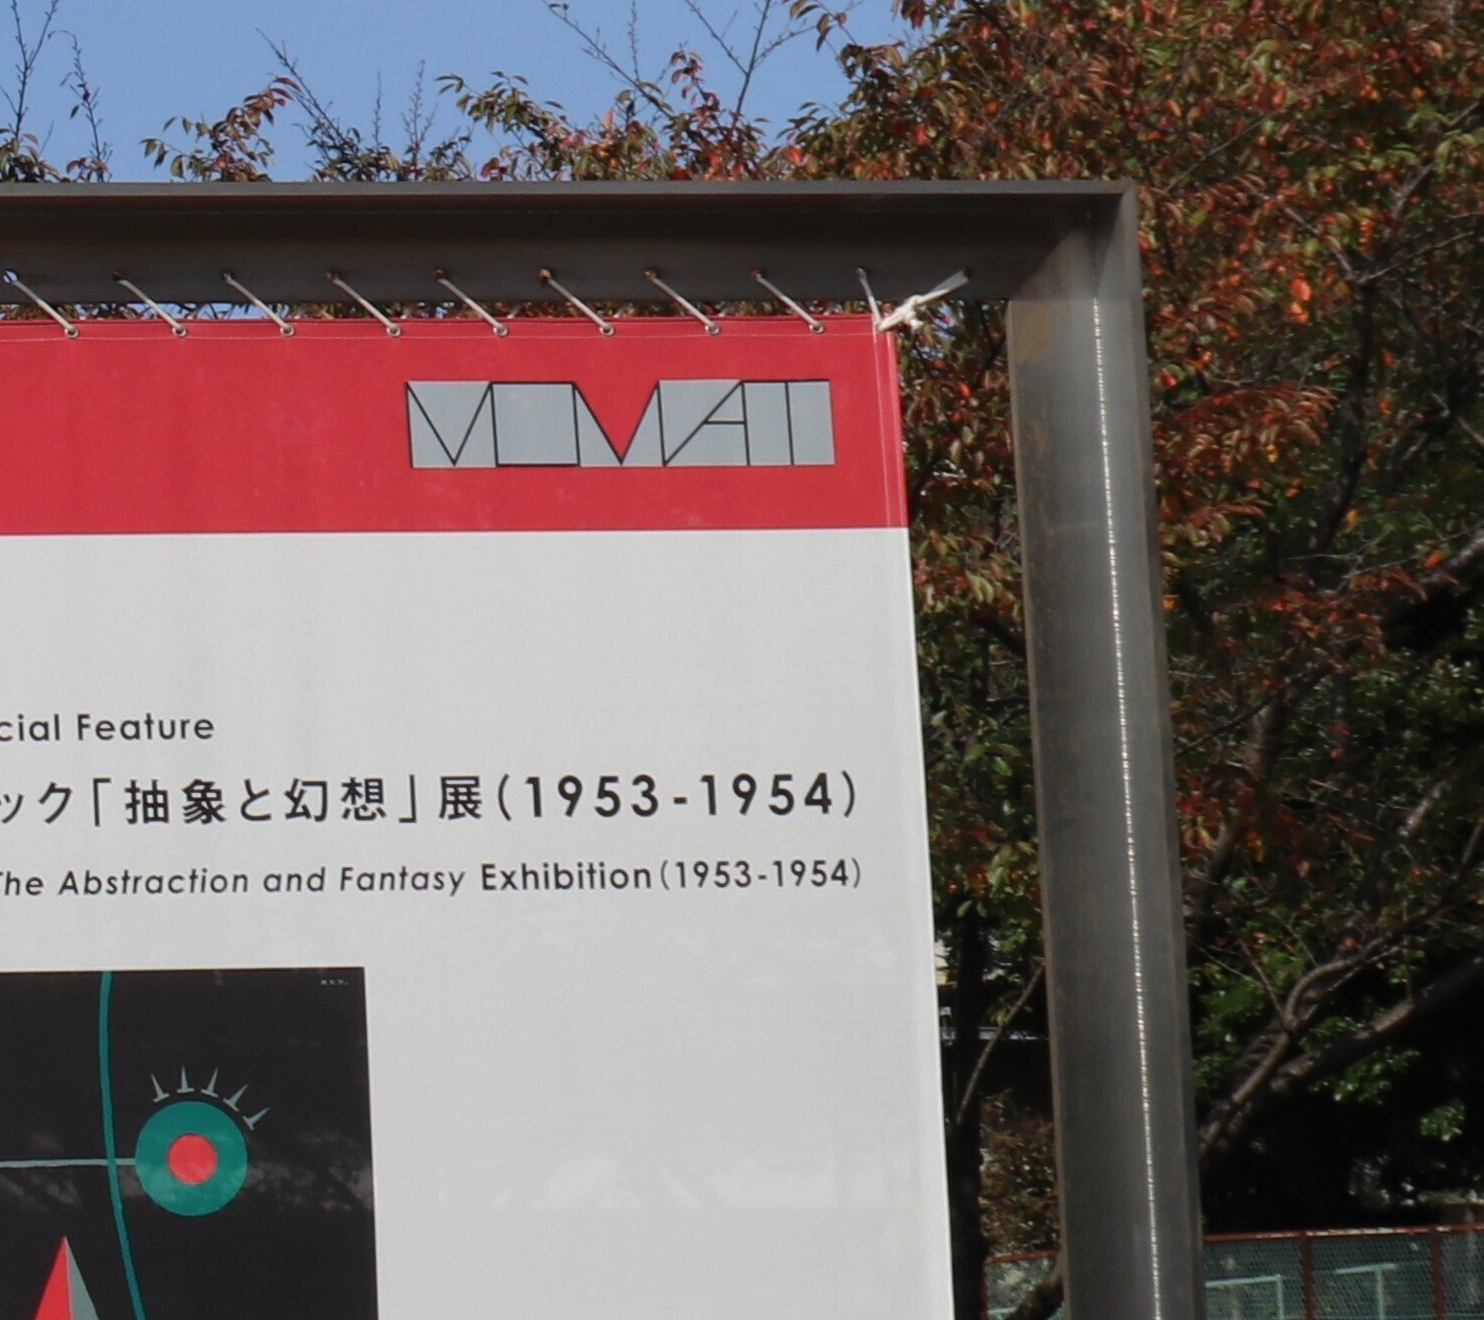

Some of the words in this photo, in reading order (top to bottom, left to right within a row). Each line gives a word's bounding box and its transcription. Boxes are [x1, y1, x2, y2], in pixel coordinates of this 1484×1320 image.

[77, 712, 215, 741] Feature
[57, 867, 249, 896] Abstraction
[262, 866, 326, 893] and
[339, 865, 465, 897] Fantasy
